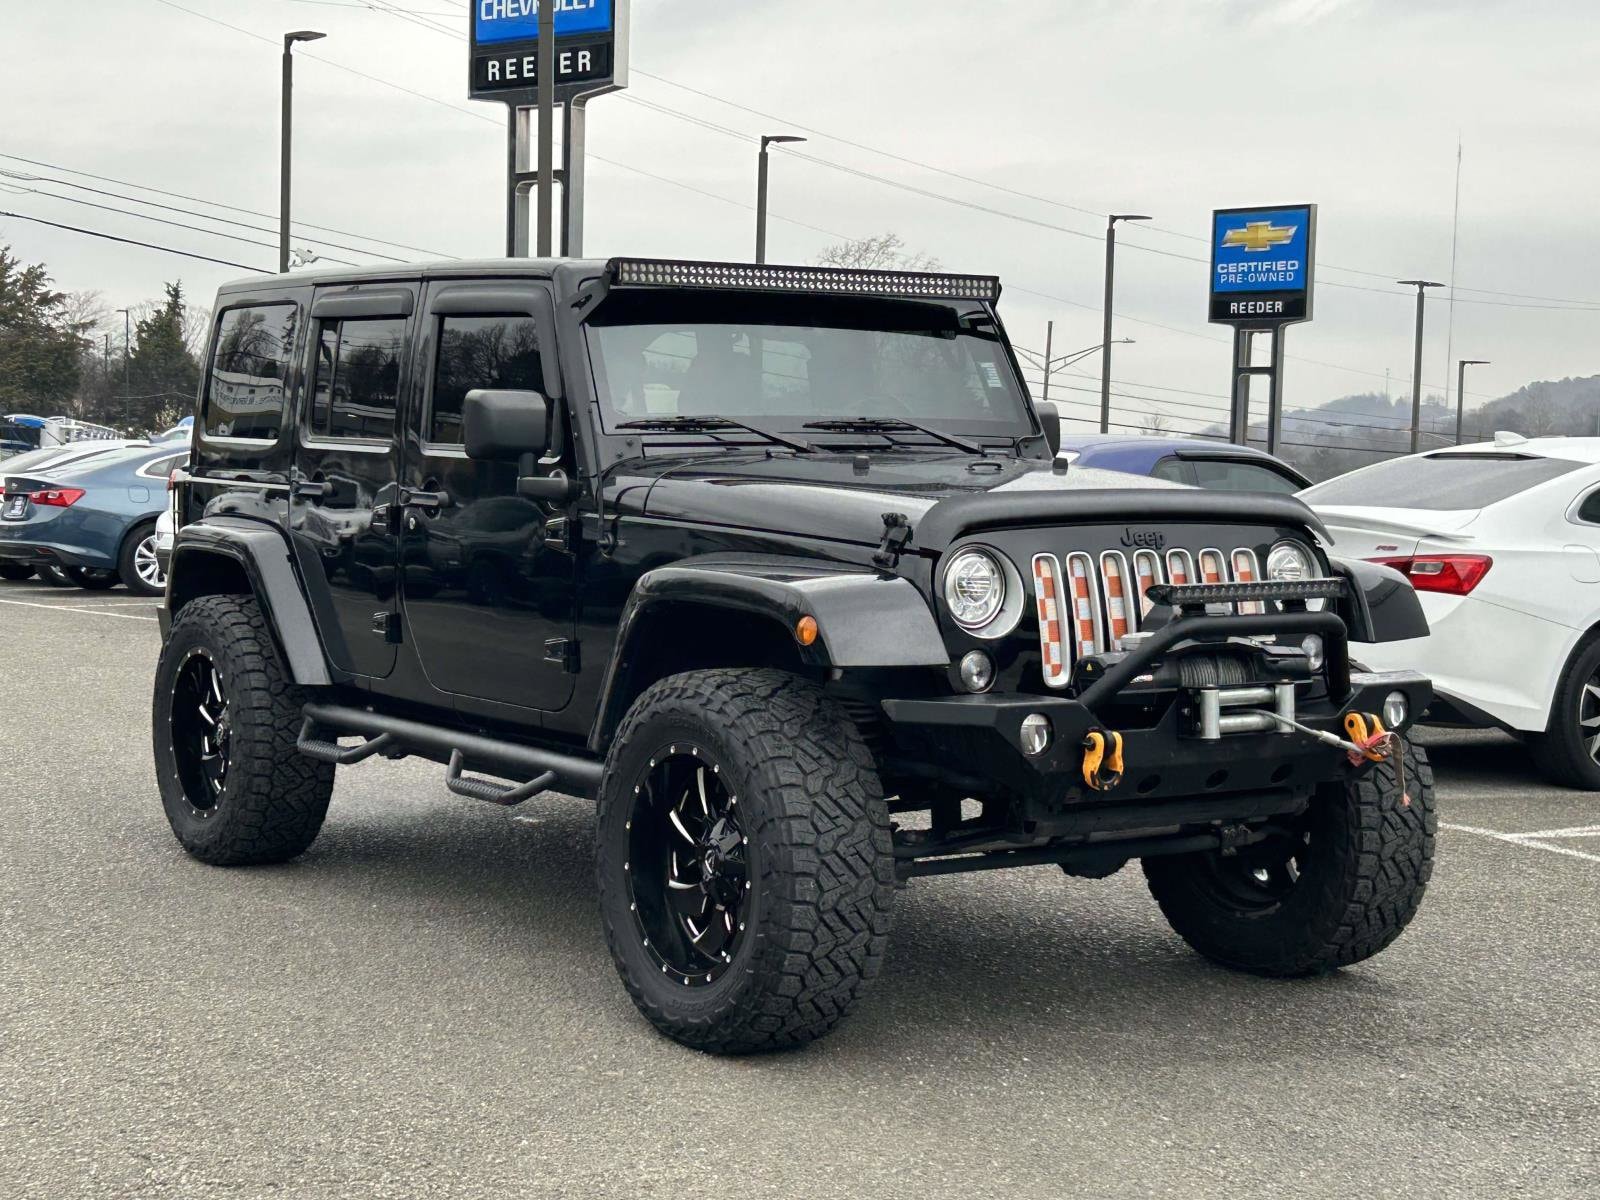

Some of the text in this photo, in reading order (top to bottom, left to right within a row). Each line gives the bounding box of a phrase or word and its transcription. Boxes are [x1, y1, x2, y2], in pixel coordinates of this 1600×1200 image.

[480, 0, 595, 20] CHEVL
[487, 50, 591, 81] REEER
[1217, 260, 1299, 273] CERTIFIED
[1220, 271, 1294, 283] PRE-OWNED
[1230, 301, 1283, 314] REEDER
[1120, 527, 1166, 550] Jeep
